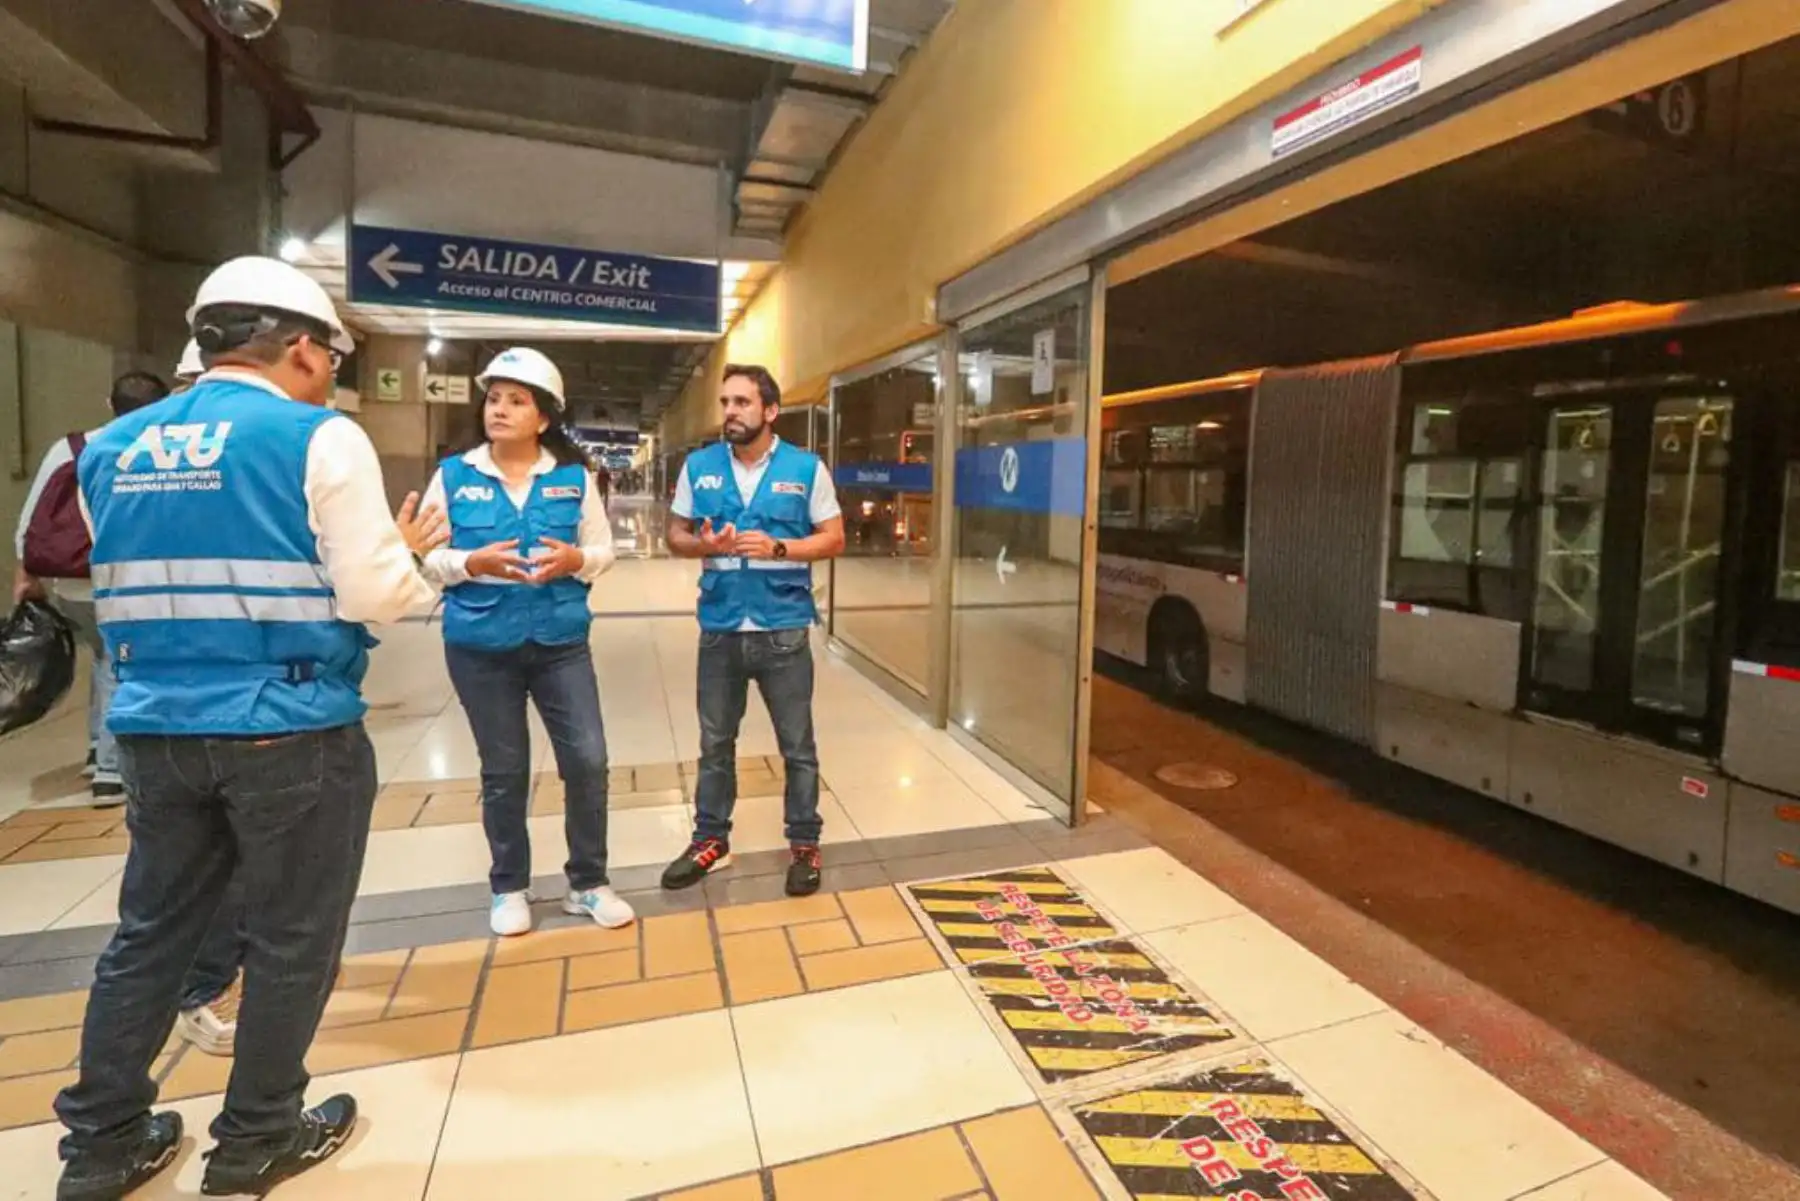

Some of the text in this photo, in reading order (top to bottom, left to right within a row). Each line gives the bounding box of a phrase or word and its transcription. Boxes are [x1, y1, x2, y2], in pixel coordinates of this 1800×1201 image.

[438, 244, 652, 290] SALIDA / Exit
[438, 280, 658, 313] Acceso al CENTRO COMERCIAL
[115, 420, 233, 472] ATU
[453, 485, 495, 501] ATU
[694, 475, 723, 490] ATU
[975, 898, 1094, 1024] DE SEGURIDAD
[1000, 882, 1150, 1035] RESPETE LA ZONA
[1180, 1135, 1242, 1187] DE
